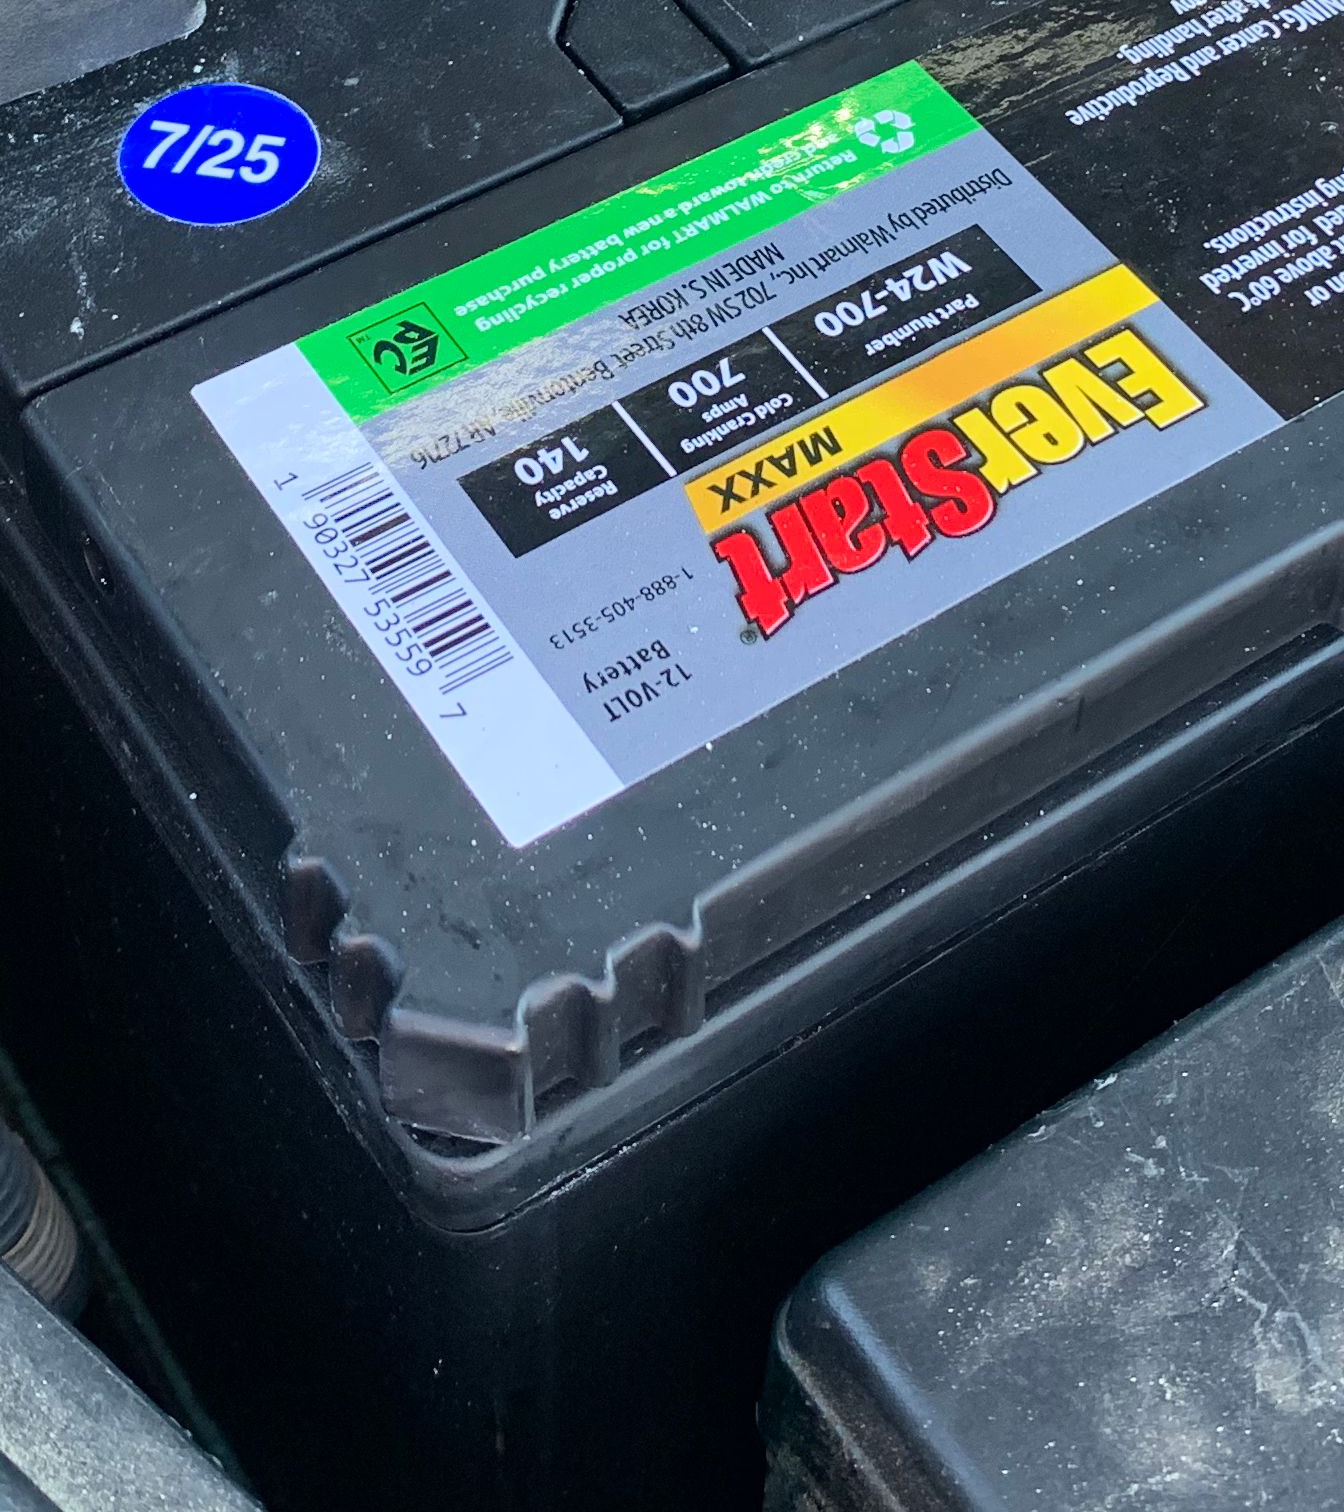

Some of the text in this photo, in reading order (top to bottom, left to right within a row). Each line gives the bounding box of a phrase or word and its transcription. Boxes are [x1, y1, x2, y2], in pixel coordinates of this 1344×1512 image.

[1110, 17, 1211, 67] handling.
[1178, 44, 1224, 76] and
[1213, 18, 1283, 57] Cancer
[1062, 60, 1191, 127] Reproductive
[142, 120, 287, 184] 7/25
[798, 131, 842, 157] and
[661, 206, 678, 219] a
[673, 173, 750, 215] toward
[909, 167, 1013, 226] Distributed
[472, 147, 859, 334] Return to WALMART for proper recycling
[621, 213, 664, 239] new
[884, 210, 920, 235] by
[1202, 188, 1329, 257] instructions.
[1278, 224, 1320, 251] for
[546, 232, 625, 275] battery
[807, 224, 897, 274] Walmart
[1198, 239, 1291, 295] inverted
[1272, 244, 1340, 285] above
[451, 265, 548, 318] purchase
[617, 241, 786, 331] MADE IN S. KOREA
[733, 280, 778, 310] 702
[811, 249, 972, 338] W24-700
[1302, 284, 1332, 307] or
[668, 312, 711, 342] 8th
[703, 296, 743, 328] SW
[862, 291, 981, 358] Part Number
[608, 328, 677, 372] Street
[665, 356, 746, 409] 700
[699, 391, 750, 424] Amps
[678, 391, 795, 455] Cold Cranking
[511, 434, 591, 487] 140
[532, 462, 610, 509] Capacity
[705, 425, 845, 514] MAXX
[712, 326, 1207, 640] EverStart
[547, 479, 619, 521] Reserve
[272, 471, 468, 722] 1 90327 53559 7
[547, 565, 695, 651] 1-888-405-3513
[579, 637, 672, 696] Battery
[600, 662, 693, 723] 12-VOLT
